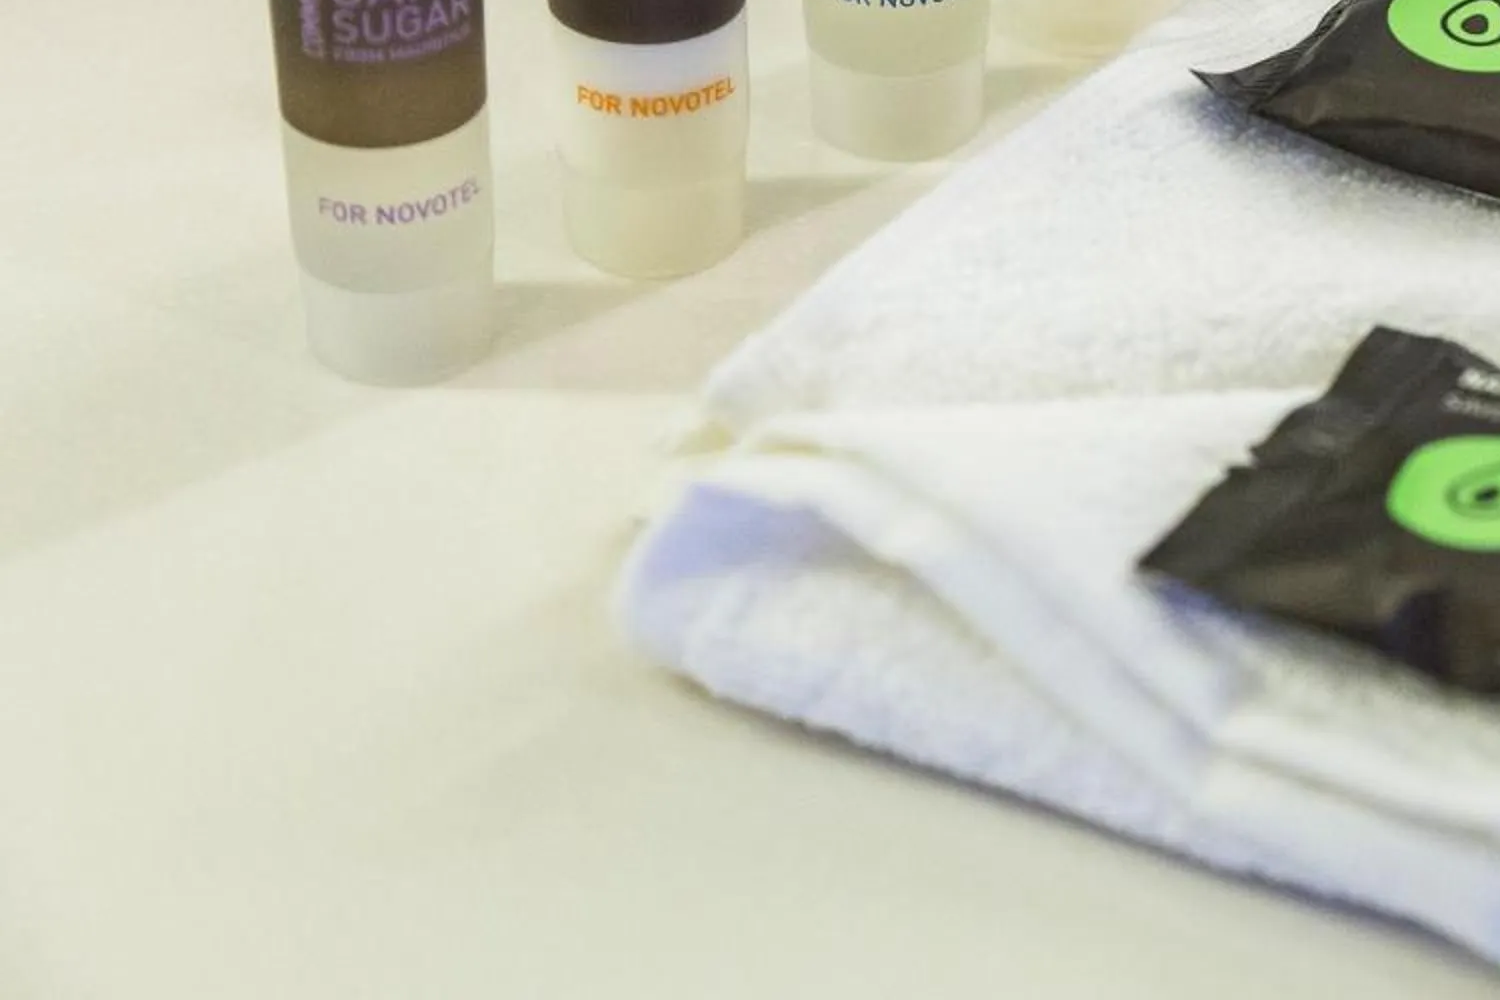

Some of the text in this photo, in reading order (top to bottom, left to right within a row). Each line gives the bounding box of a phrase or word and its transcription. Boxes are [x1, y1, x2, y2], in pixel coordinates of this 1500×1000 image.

[576, 75, 736, 118] FOR NOVOTEL
[318, 176, 481, 225] FOR NOVOTEL
